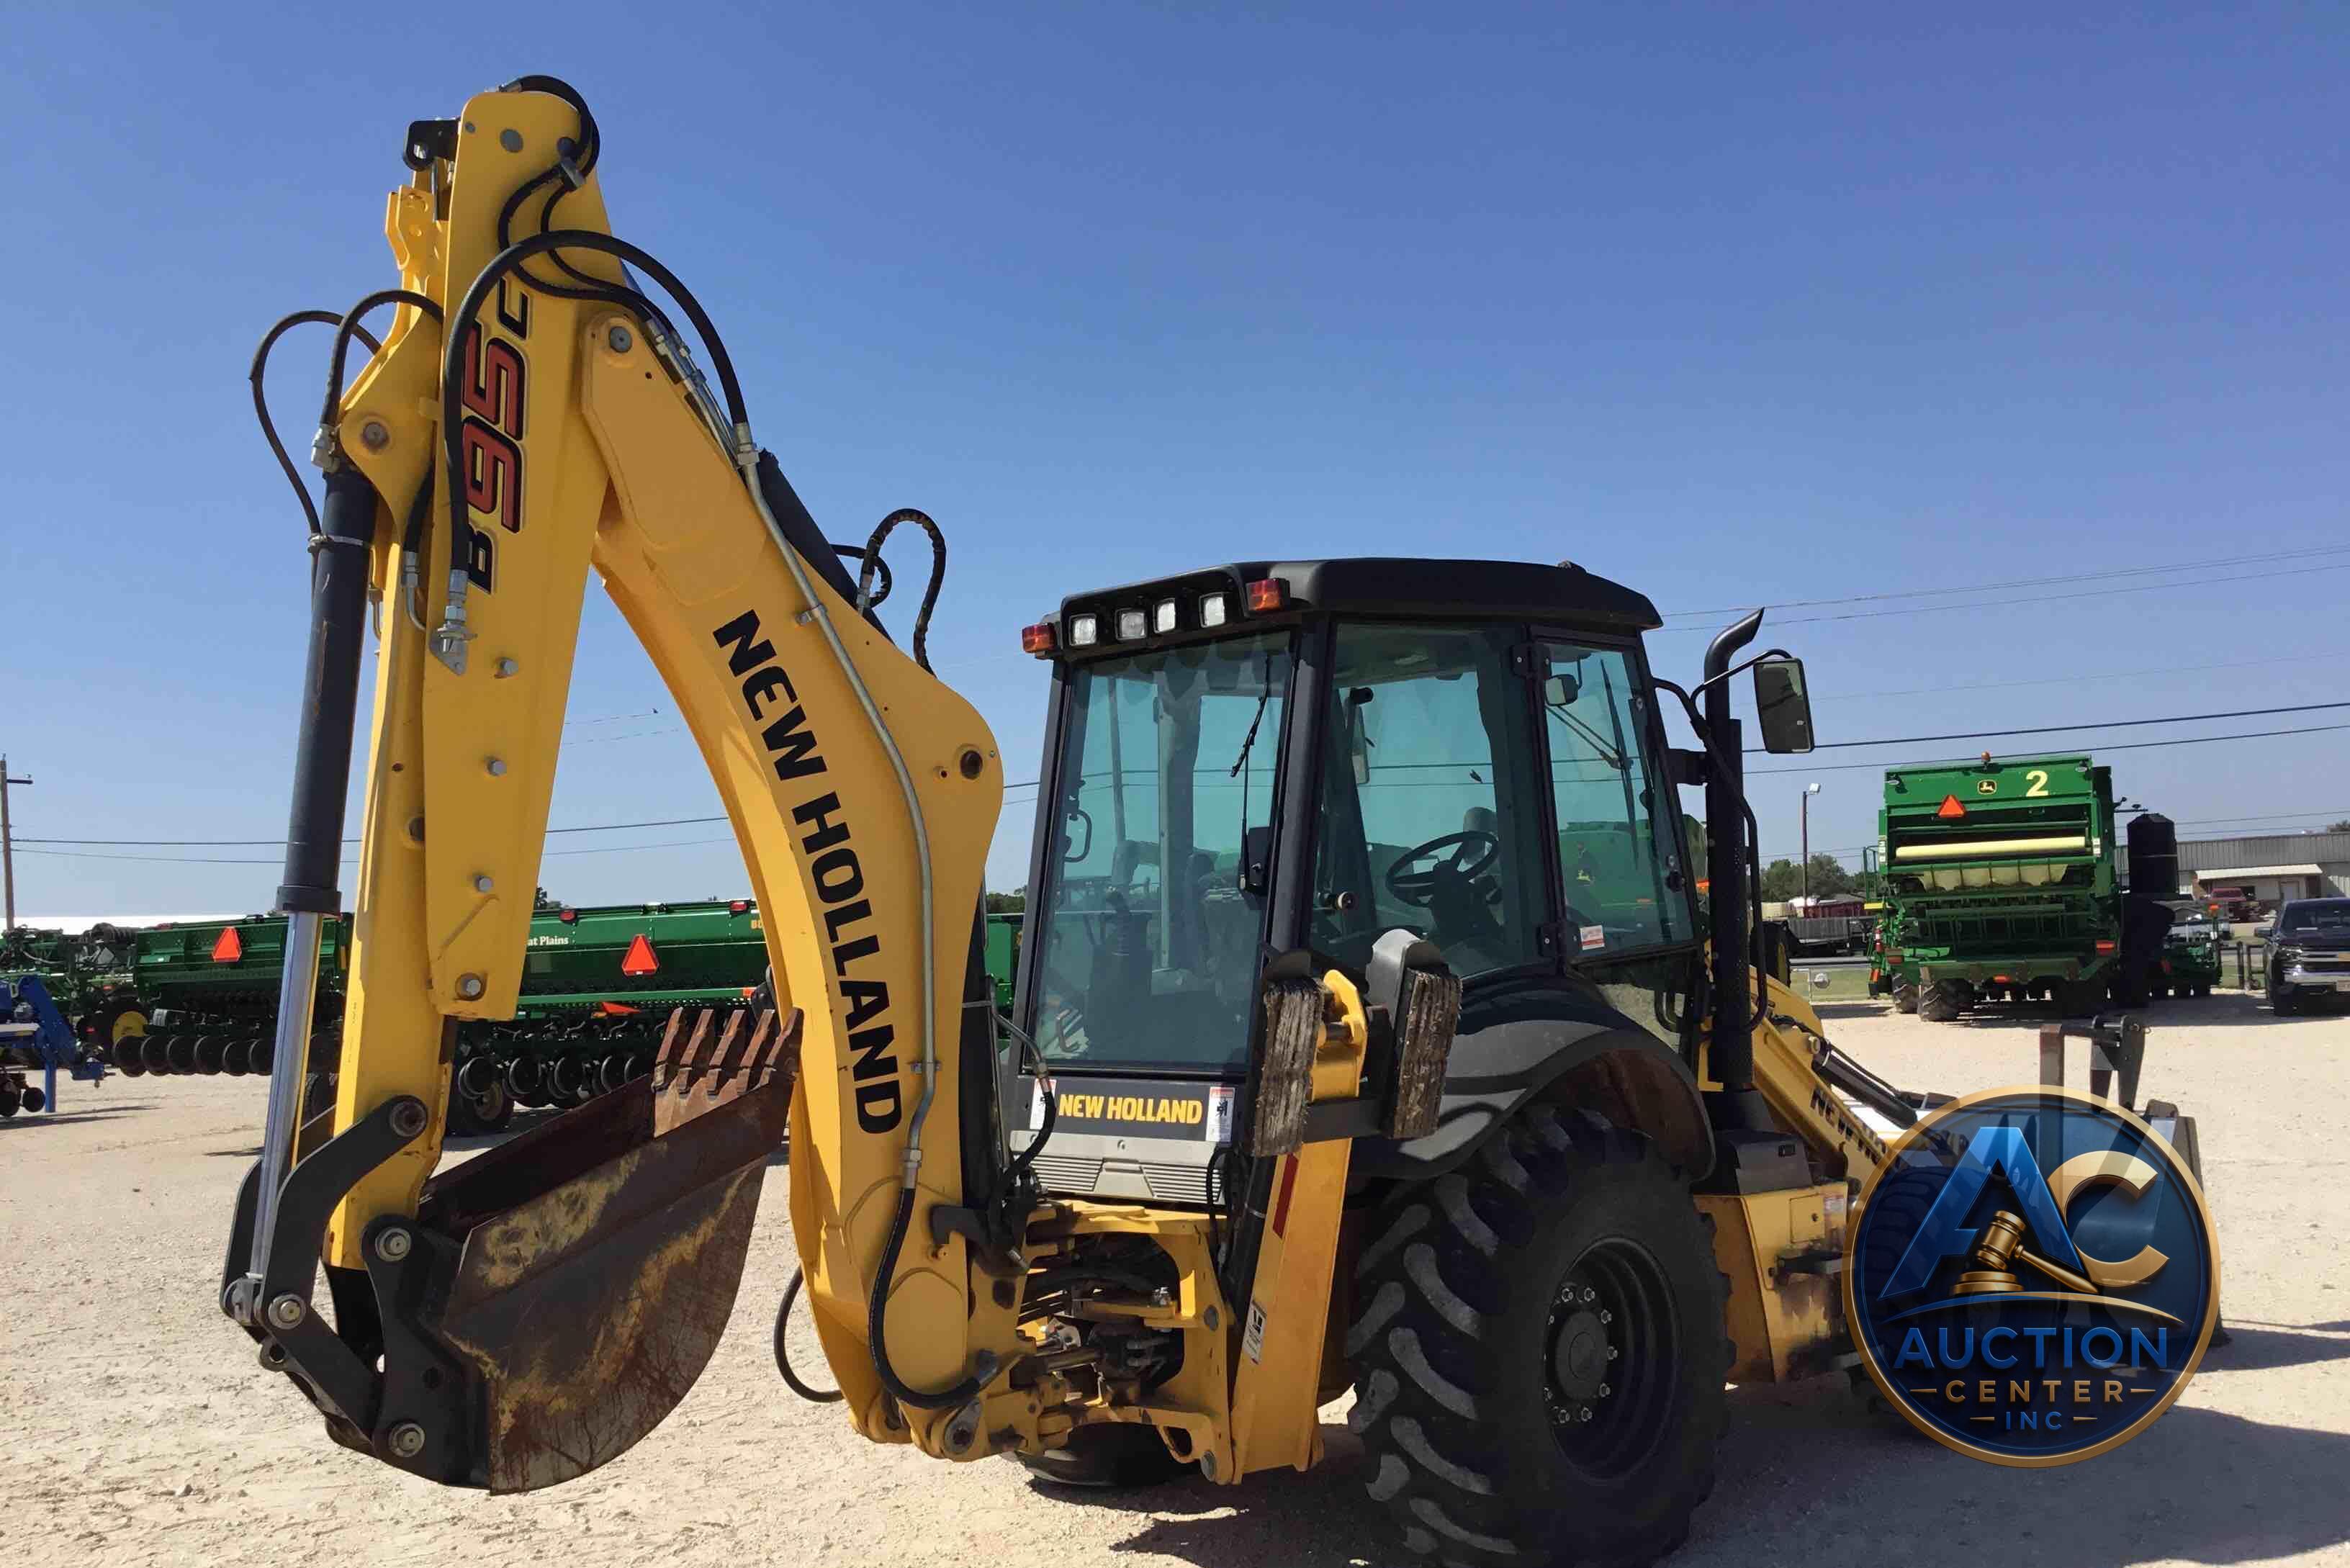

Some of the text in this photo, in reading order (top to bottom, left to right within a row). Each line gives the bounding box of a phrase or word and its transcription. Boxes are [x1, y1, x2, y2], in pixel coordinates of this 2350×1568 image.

[462, 275, 529, 595] B95C
[2025, 770, 2049, 797] 2
[712, 609, 903, 1135] NEW HOLLAND
[539, 934, 570, 946] Plains
[1058, 1094, 1104, 1119] NEW
[1106, 1096, 1203, 1125] HOLLAND
